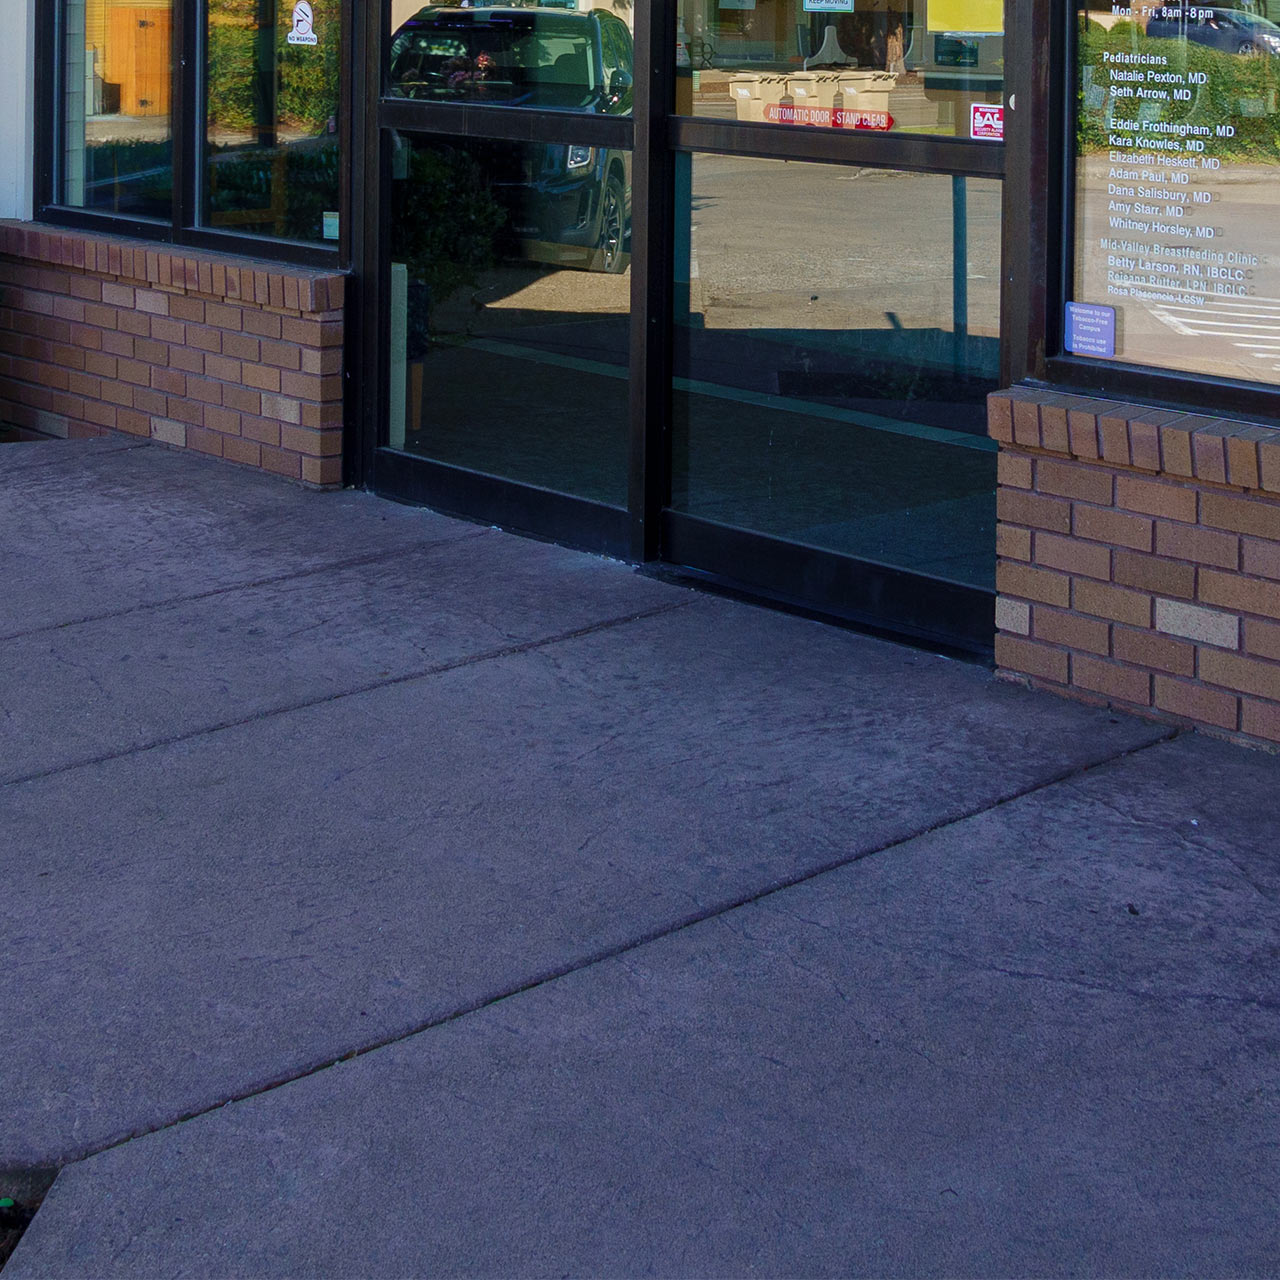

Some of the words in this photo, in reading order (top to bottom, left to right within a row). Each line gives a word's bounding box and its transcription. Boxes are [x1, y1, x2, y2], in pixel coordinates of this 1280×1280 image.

[1112, 5, 1131, 16] Mon
[1162, 6, 1182, 17] 8am
[1103, 52, 1167, 65] Pediatricians
[1110, 69, 1144, 81] Natalie
[1147, 71, 1185, 85] Pexton,
[1188, 72, 1206, 84] MD
[1110, 86, 1133, 97] Seth
[1136, 87, 1170, 100] Arrow,
[1173, 89, 1191, 100] MD
[769, 107, 808, 120] AUTOMATIC
[810, 110, 830, 123] DOOR
[836, 112, 860, 125] STAND
[862, 113, 886, 126] CLEAR
[1110, 119, 1139, 131] Eddie
[1142, 121, 1213, 136] Frothingham,
[1216, 125, 1235, 137] MD
[1109, 135, 1132, 147] Kara
[1135, 136, 1183, 152] Knowles,
[1186, 140, 1204, 152] MD
[1109, 151, 1154, 165] Elizabeth
[1202, 158, 1220, 170] MD
[1109, 168, 1138, 180] Adam
[1141, 170, 1168, 184] Paul,
[1171, 173, 1189, 185] MD
[1108, 184, 1134, 197] Dana
[1137, 186, 1190, 203] Salisbury,
[1193, 192, 1211, 203] MD
[1109, 200, 1131, 215] Amy
[1166, 206, 1184, 217] MD
[1109, 216, 1150, 234] Whitney
[1195, 226, 1214, 239] MD
[1100, 238, 1150, 256] Mid-Valley
[1153, 244, 1224, 264] Breastfeeding
[1227, 252, 1258, 266] Clinic
[1108, 255, 1136, 271] Betty
[1138, 259, 1179, 275] Larson,
[1207, 266, 1244, 281] IBCLC
[1108, 285, 1128, 296] Rosa
[1213, 282, 1246, 297] IBCLC
